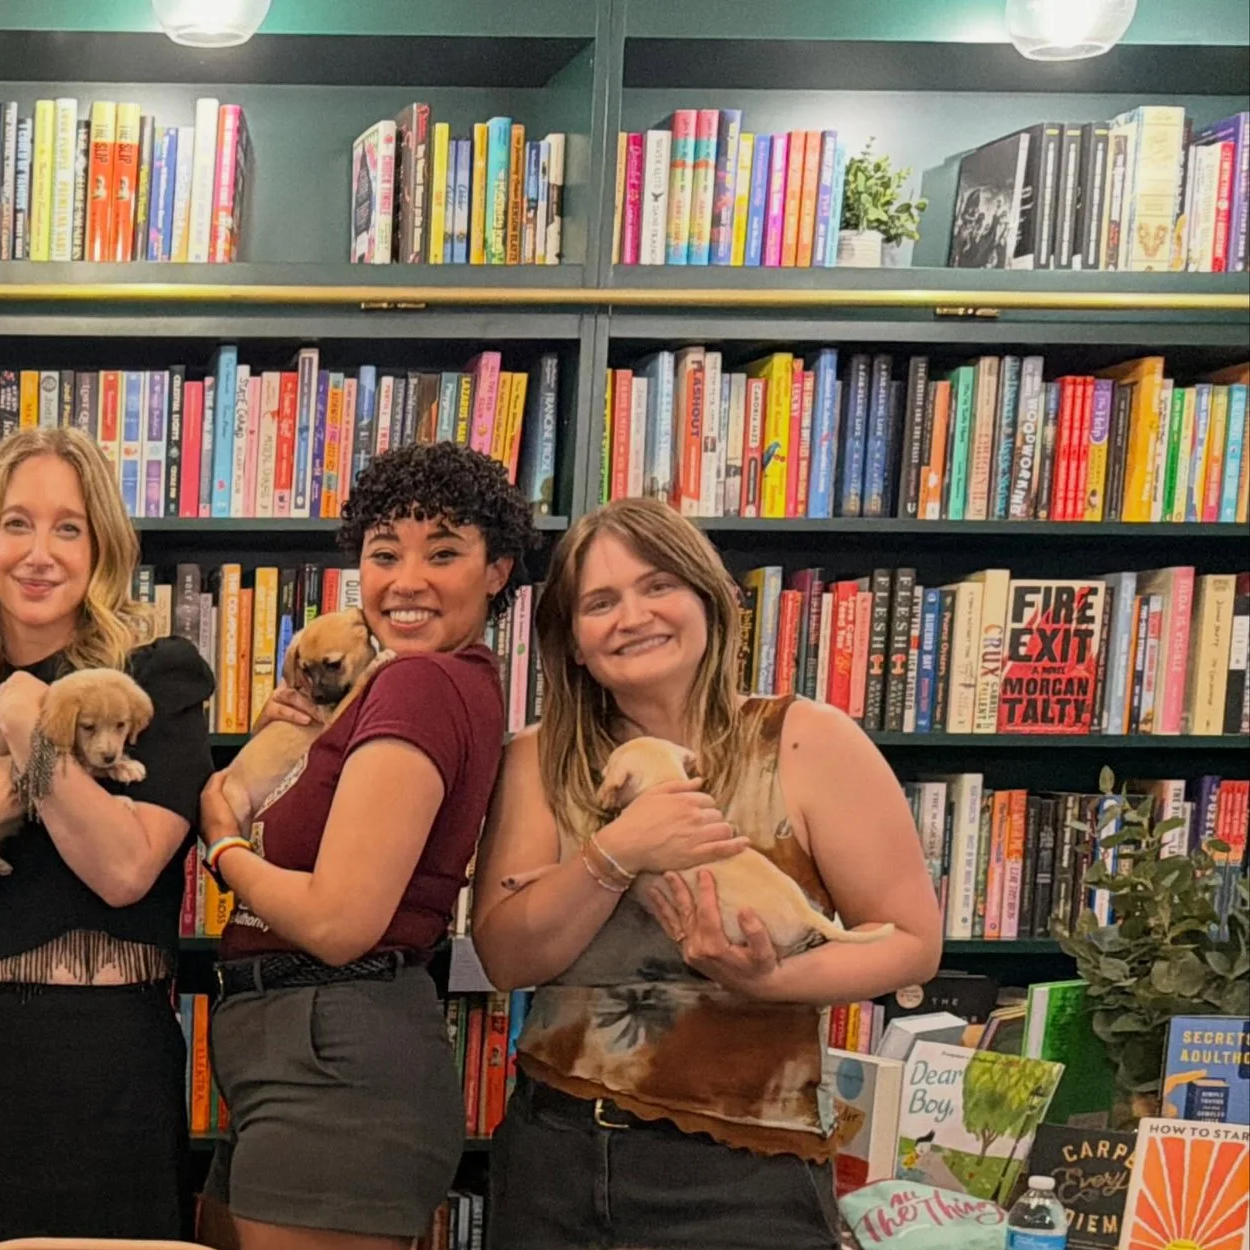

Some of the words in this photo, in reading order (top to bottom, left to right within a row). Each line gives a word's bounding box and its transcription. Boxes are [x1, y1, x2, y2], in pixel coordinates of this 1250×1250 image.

[236, 377, 249, 405] STATE
[460, 376, 470, 418] LAZARUS
[690, 359, 704, 438] FLASHOUT
[1096, 398, 1106, 409] The
[442, 383, 453, 431] Playground
[543, 392, 555, 440] FRANCINE
[172, 414, 181, 440] LIGHTS
[457, 421, 466, 442] MAN
[1091, 410, 1106, 437] Help
[541, 442, 553, 472] PROSE
[1011, 396, 1041, 516] WOODWORKING
[185, 575, 193, 601] WOLF
[227, 573, 240, 593] THE
[847, 596, 856, 621] Love
[872, 576, 890, 648] FLESH
[894, 576, 912, 648] FLESH
[1012, 586, 1098, 625] FIRE
[923, 613, 935, 651] BLUEBIRD
[941, 611, 952, 640] Pearce
[938, 642, 949, 676] Oysters
[980, 624, 1003, 678] CRUX
[1008, 627, 1095, 663] EXIT
[922, 654, 931, 669] DAY
[1031, 666, 1040, 675] A
[977, 681, 989, 720] TALLENT
[988, 681, 999, 720] GABRIEL
[1002, 677, 1088, 697] MORGAN
[1002, 697, 1089, 725] TALTY
[931, 792, 940, 808] THE
[931, 998, 958, 1006] THE
[909, 1060, 963, 1085] Dear
[908, 1088, 955, 1123] Boy,
[1150, 1124, 1185, 1135] HOW
[1190, 1127, 1210, 1137] TO
[1051, 1167, 1130, 1204] Every
[861, 1204, 918, 1244] The
[1064, 1207, 1118, 1234] DIEM
